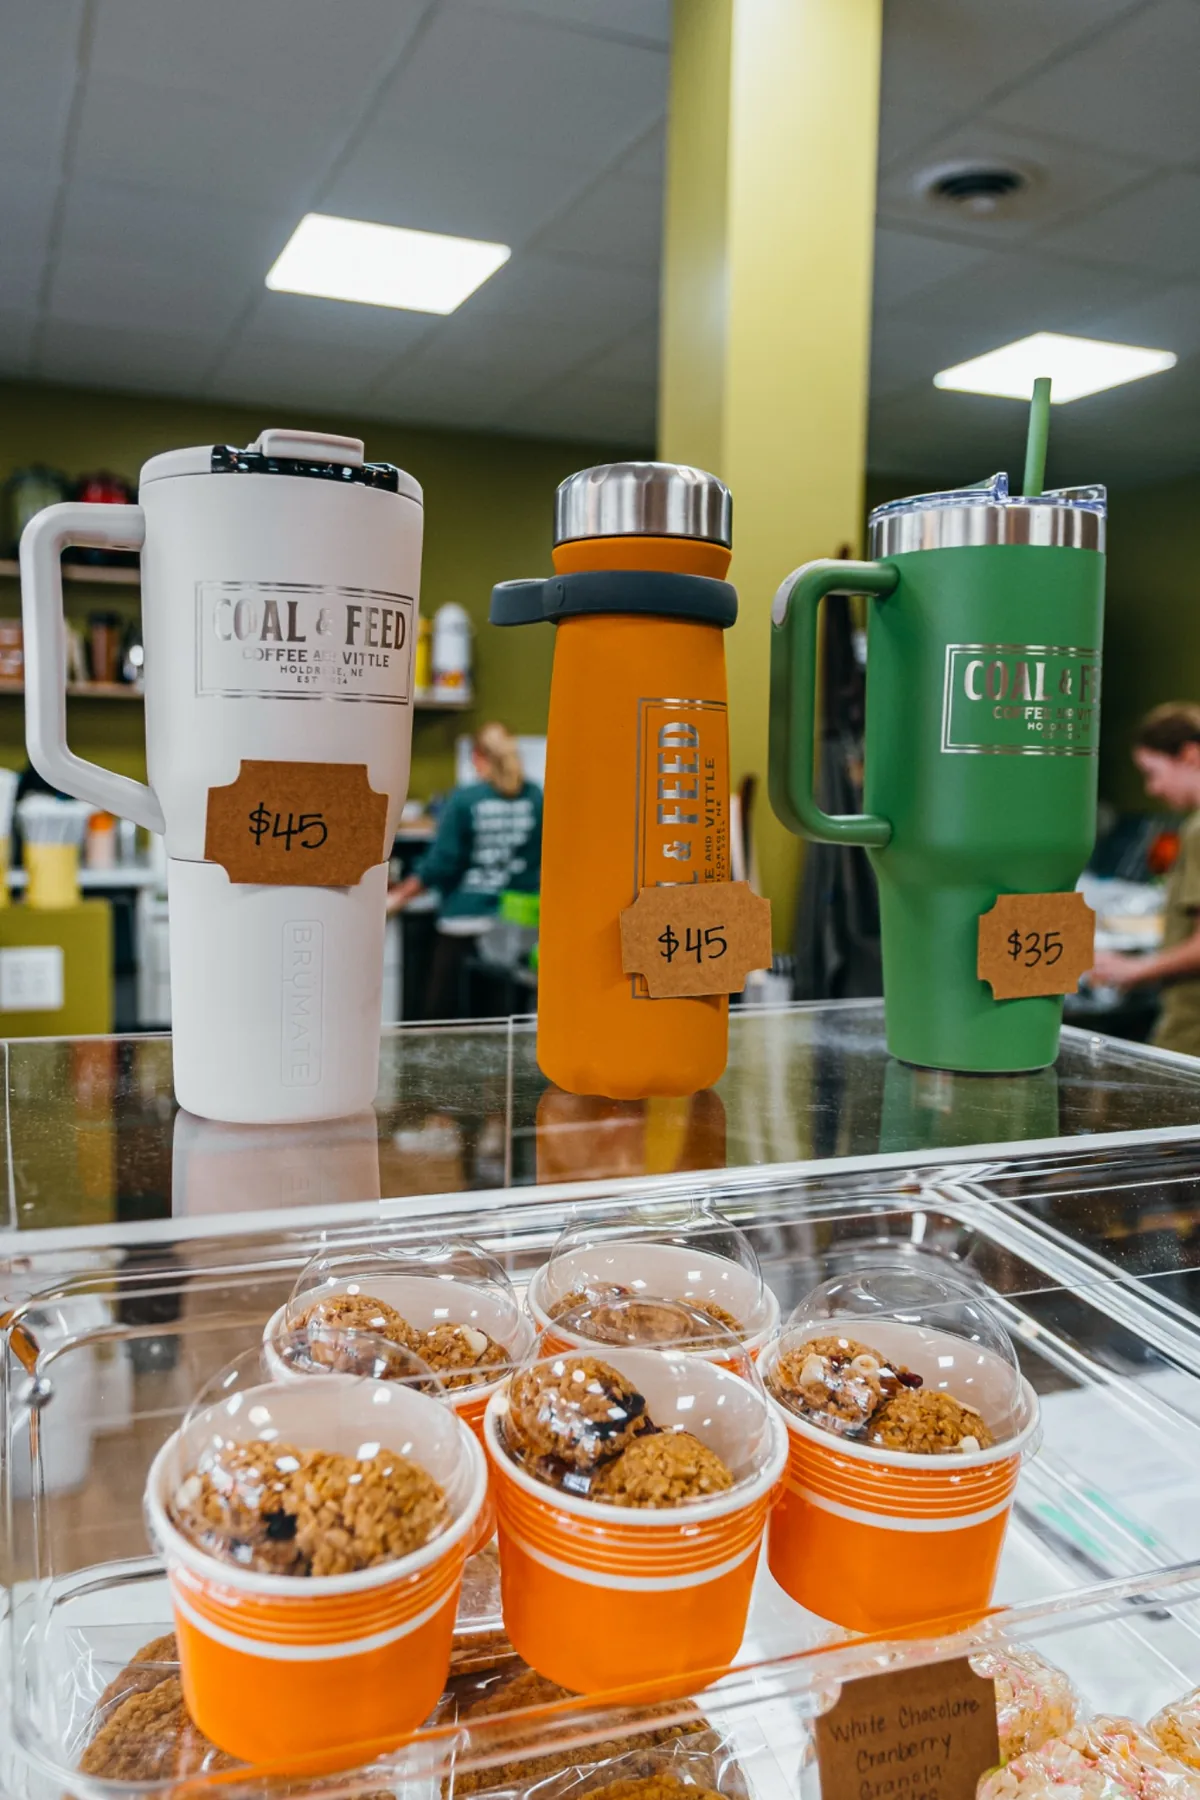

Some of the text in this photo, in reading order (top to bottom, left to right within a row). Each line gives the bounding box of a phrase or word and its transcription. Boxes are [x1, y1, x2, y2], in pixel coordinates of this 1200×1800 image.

[213, 598, 406, 650] COAL & FEED
[242, 647, 308, 663] COFFEE
[342, 651, 390, 668] VITTLE
[280, 665, 363, 678] HOLDRE, NE
[297, 676, 318, 684] EST
[964, 660, 1053, 701] COAL
[1059, 669, 1072, 695] &
[657, 720, 699, 824] FEED
[705, 757, 715, 829] VITTLE
[248, 802, 328, 851] $45
[662, 840, 692, 861] &
[658, 925, 728, 964] $45
[1007, 929, 1064, 968] $35
[829, 1697, 980, 1744] White Chocolate
[857, 1733, 952, 1775] Cranberry
[859, 1764, 943, 1800] Granola
